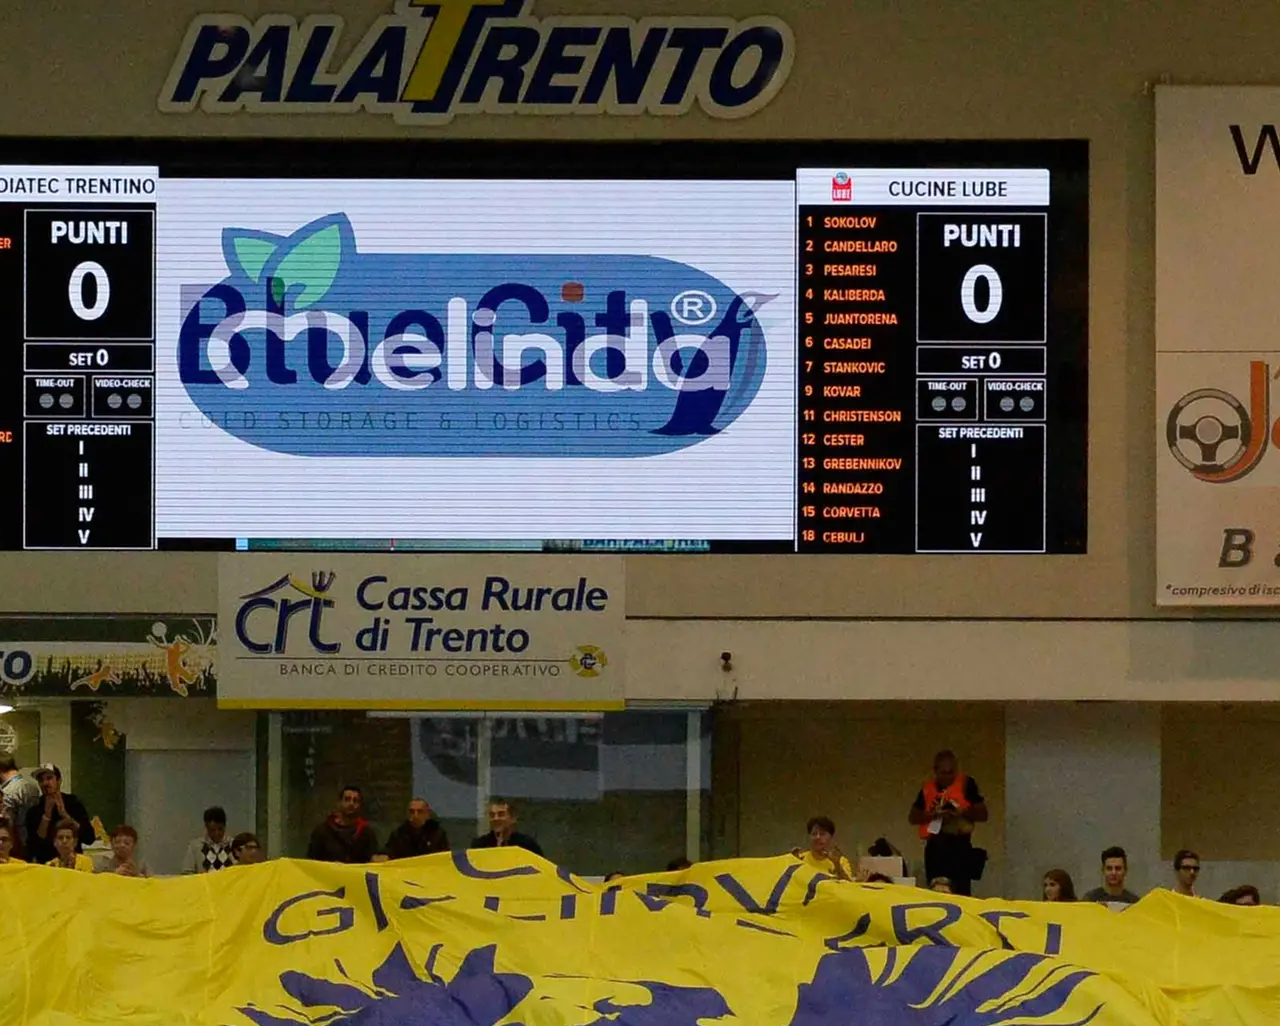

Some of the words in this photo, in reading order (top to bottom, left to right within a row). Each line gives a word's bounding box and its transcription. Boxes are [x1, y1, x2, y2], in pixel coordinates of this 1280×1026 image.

[172, 0, 784, 114] PALATRENTO
[66, 178, 154, 193] TRENTINO
[889, 181, 955, 196] CUCINE
[963, 182, 1006, 196] LUBE
[824, 217, 876, 228] SOKOLOV
[52, 221, 127, 244] PUNTI
[944, 224, 1020, 247] PUNTI
[824, 241, 897, 252] CANDELLARO
[824, 265, 876, 276] PESARESI
[69, 261, 110, 320] 0
[824, 289, 885, 301] KALIBERDA
[961, 264, 1002, 323] 0
[824, 313, 897, 324] JUANTORENA
[824, 338, 871, 349] CASADEI
[69, 353, 93, 365] SET
[97, 349, 108, 365] 0
[824, 362, 885, 373] STANKOVIC
[35, 379, 74, 387] TIME-OUT
[95, 379, 150, 387] VIDEO-CHECK
[928, 382, 966, 390] TIME-OUT
[988, 382, 1042, 390] VIDEO-CHECK
[824, 386, 860, 397] KOVAR
[279, 412, 418, 430] STORAGE
[475, 412, 641, 431] LOGISTICS
[824, 411, 901, 421] CHRISTENSON
[47, 424, 66, 435] SET
[68, 425, 131, 435] PRECEDENTI
[824, 434, 864, 445] CESTER
[824, 458, 901, 469] GREBENNIKOV
[824, 483, 883, 494] RANDAZZO
[823, 507, 880, 517] CORVETTA
[823, 532, 864, 542] CEBULJ
[1219, 529, 1254, 567] B
[357, 576, 468, 610] Cassa
[482, 577, 608, 611] Rurale
[356, 617, 390, 651] di
[405, 618, 529, 652] Trento
[280, 664, 336, 675] BANCA
[344, 664, 359, 675] DI
[367, 664, 437, 675] CREDITO
[445, 665, 559, 676] COOPERATIVO
